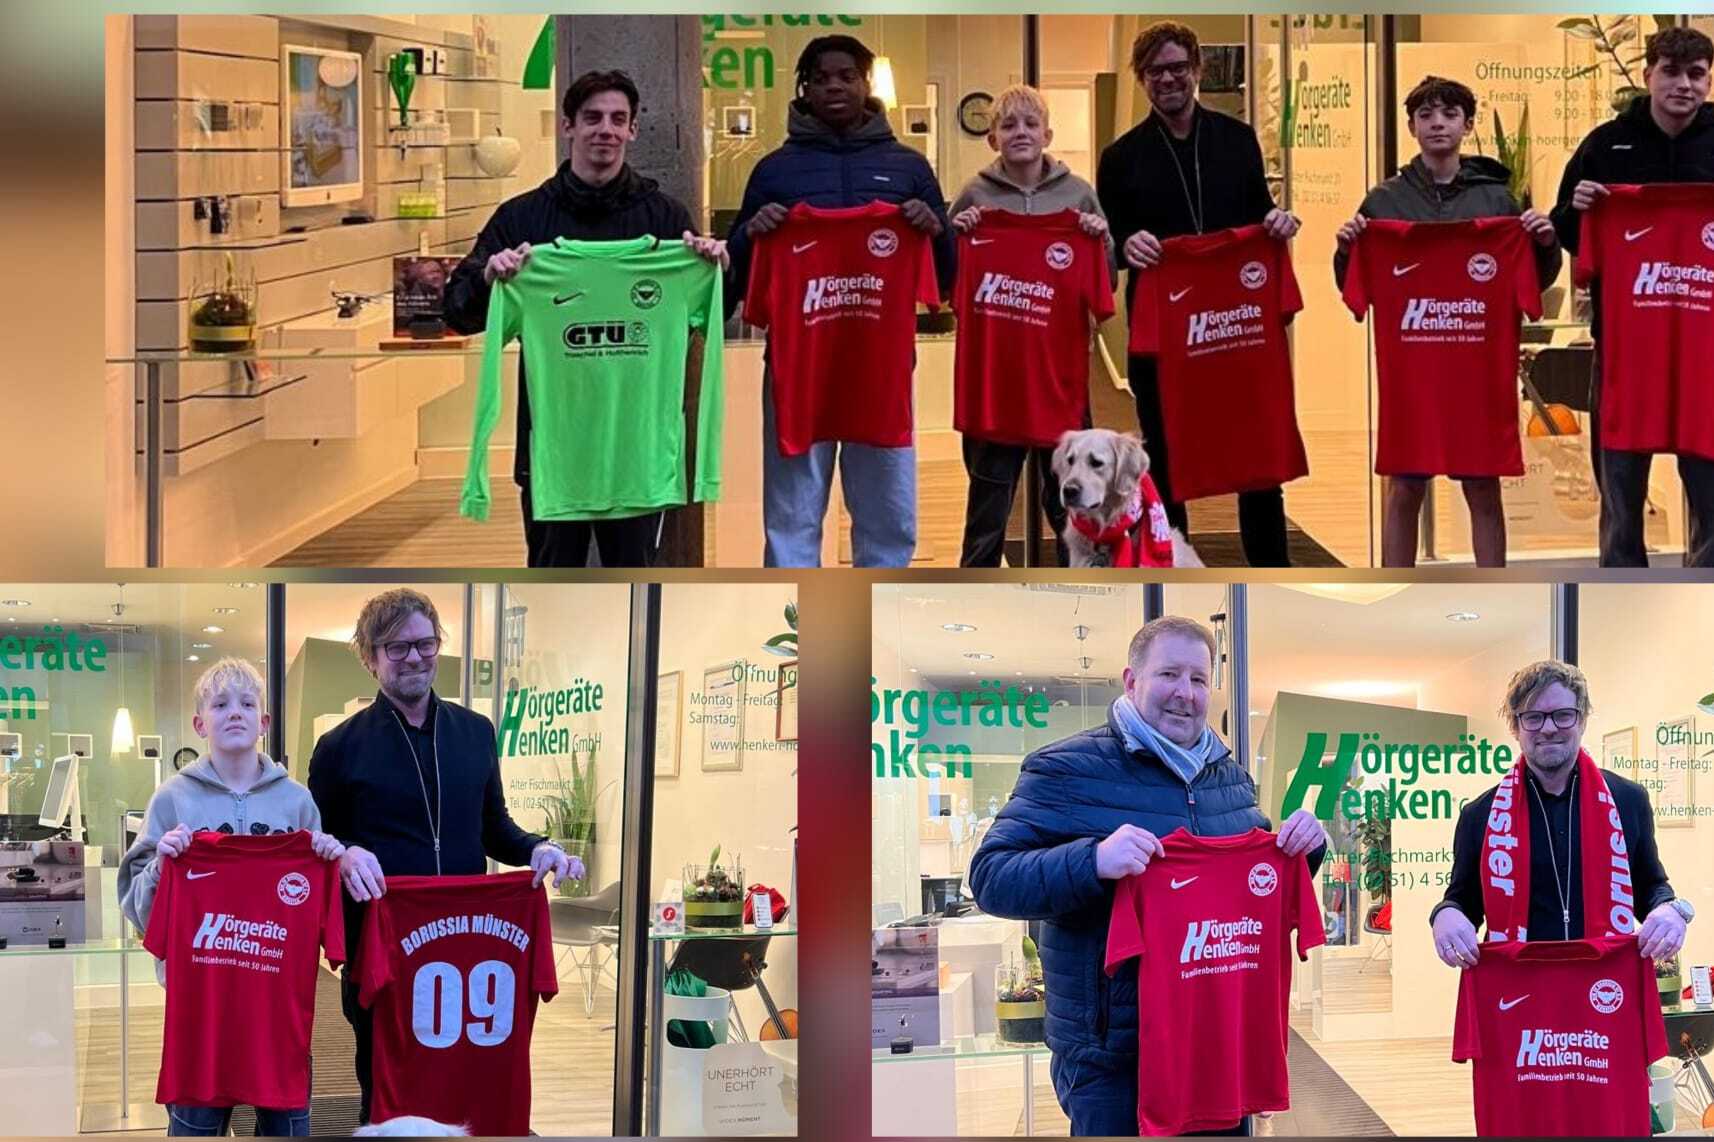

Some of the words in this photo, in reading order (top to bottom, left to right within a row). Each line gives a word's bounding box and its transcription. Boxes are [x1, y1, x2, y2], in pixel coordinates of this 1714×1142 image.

[690, 693, 733, 708] Montag
[1614, 756, 1659, 772] Montag
[1669, 756, 1712, 773] Freitag:
[400, 915, 469, 956] BORUSSIA
[471, 913, 530, 953] MÜNSTER
[260, 946, 283, 959] GmbH
[412, 960, 516, 1049] 09
[1583, 1056, 1609, 1069] GmbH
[707, 1065, 775, 1081] UNERHÖRT
[725, 1080, 757, 1093] ECHT
